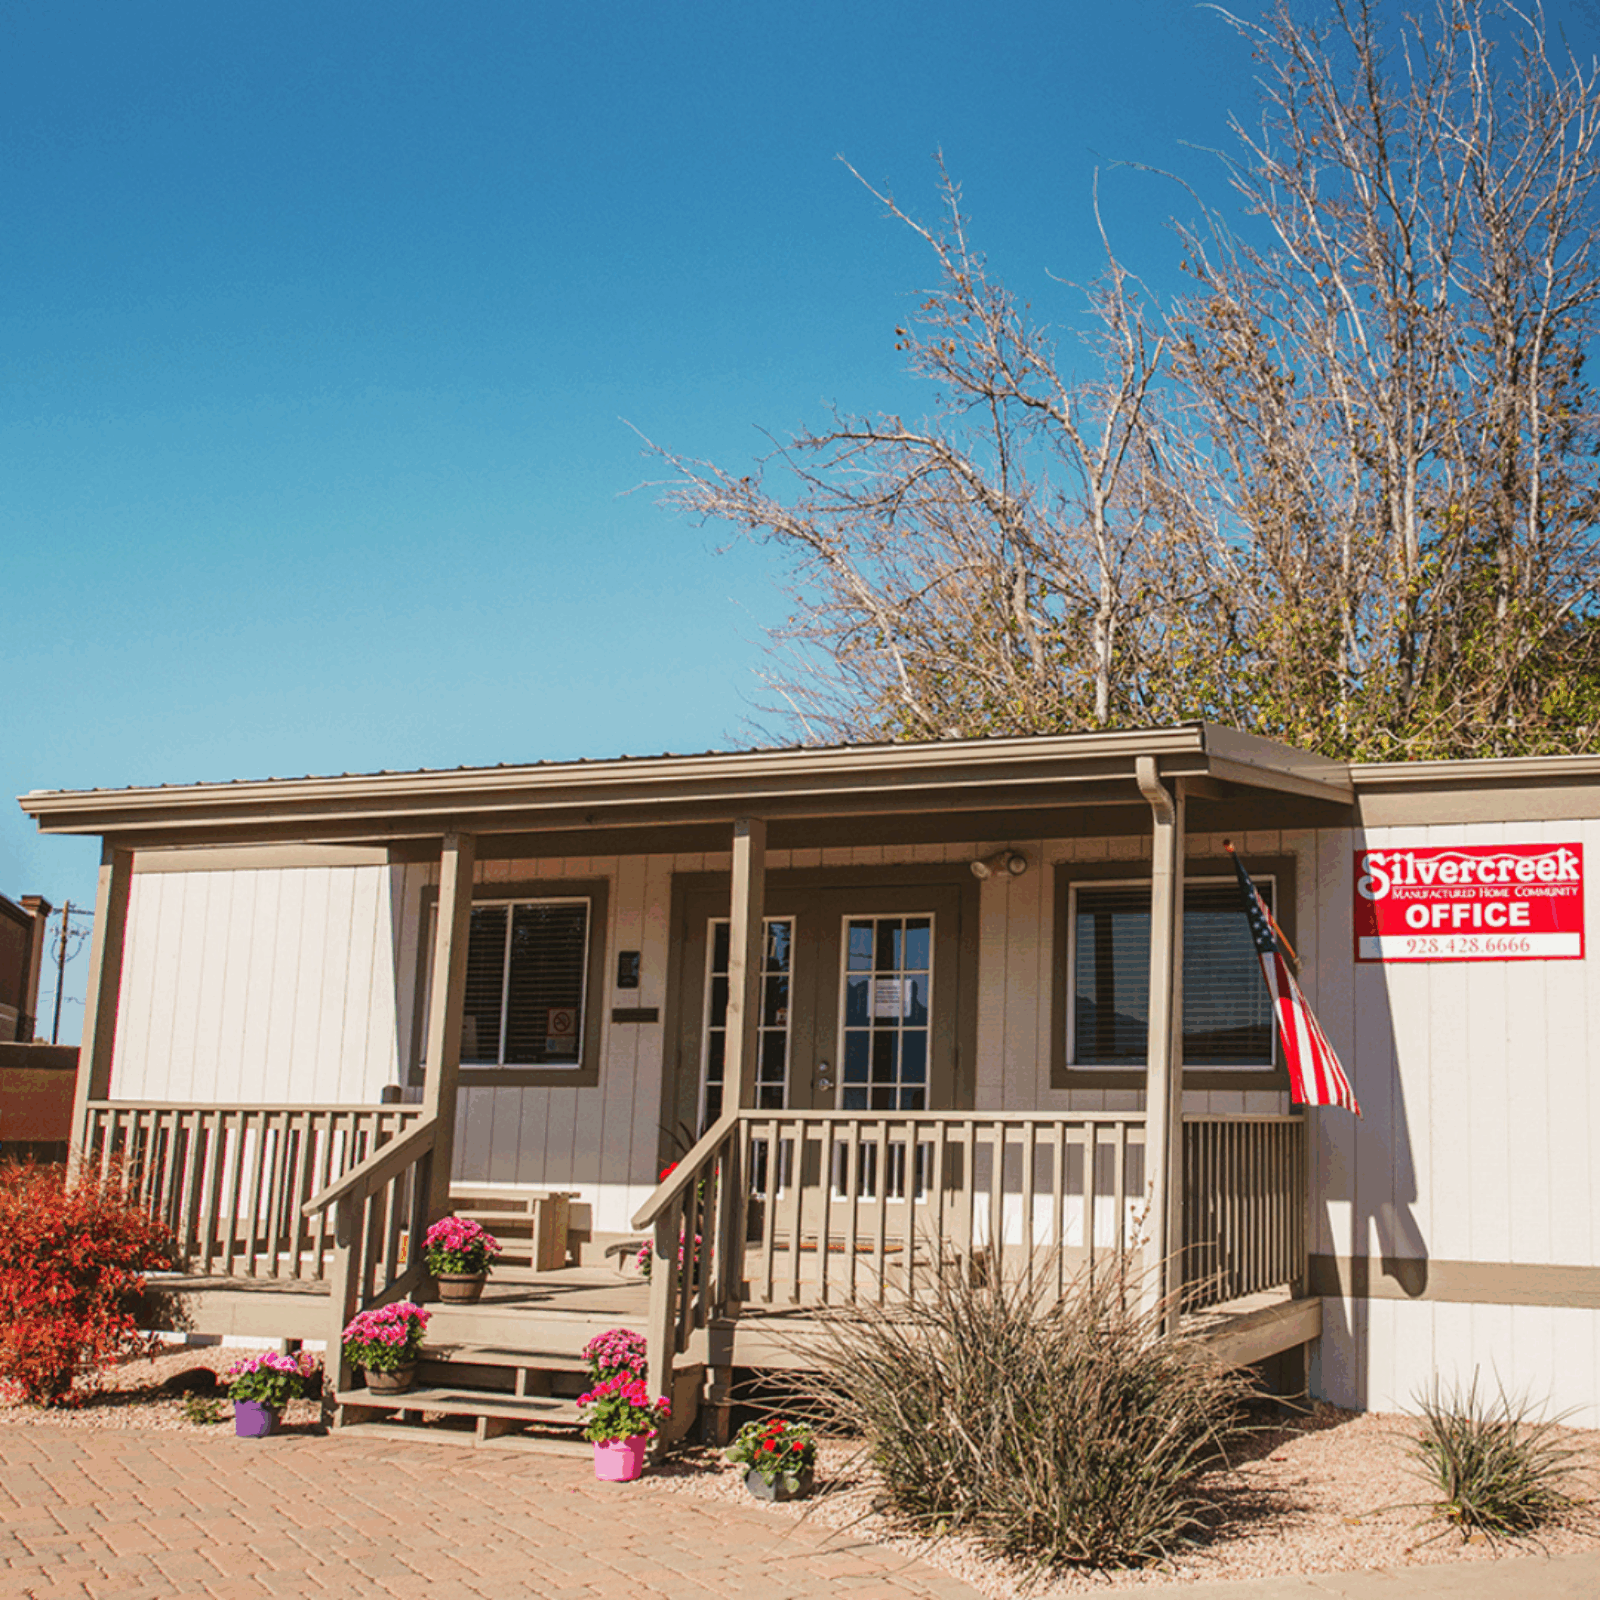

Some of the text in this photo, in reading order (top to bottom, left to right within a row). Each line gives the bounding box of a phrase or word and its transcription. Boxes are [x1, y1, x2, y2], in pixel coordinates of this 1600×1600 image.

[1357, 847, 1580, 900] Silvercreek
[1479, 887, 1510, 898] HOME
[1514, 885, 1579, 898] COMMUNITY
[1405, 902, 1531, 929] OFFICE
[1406, 936, 1531, 954] 928.428.6666
